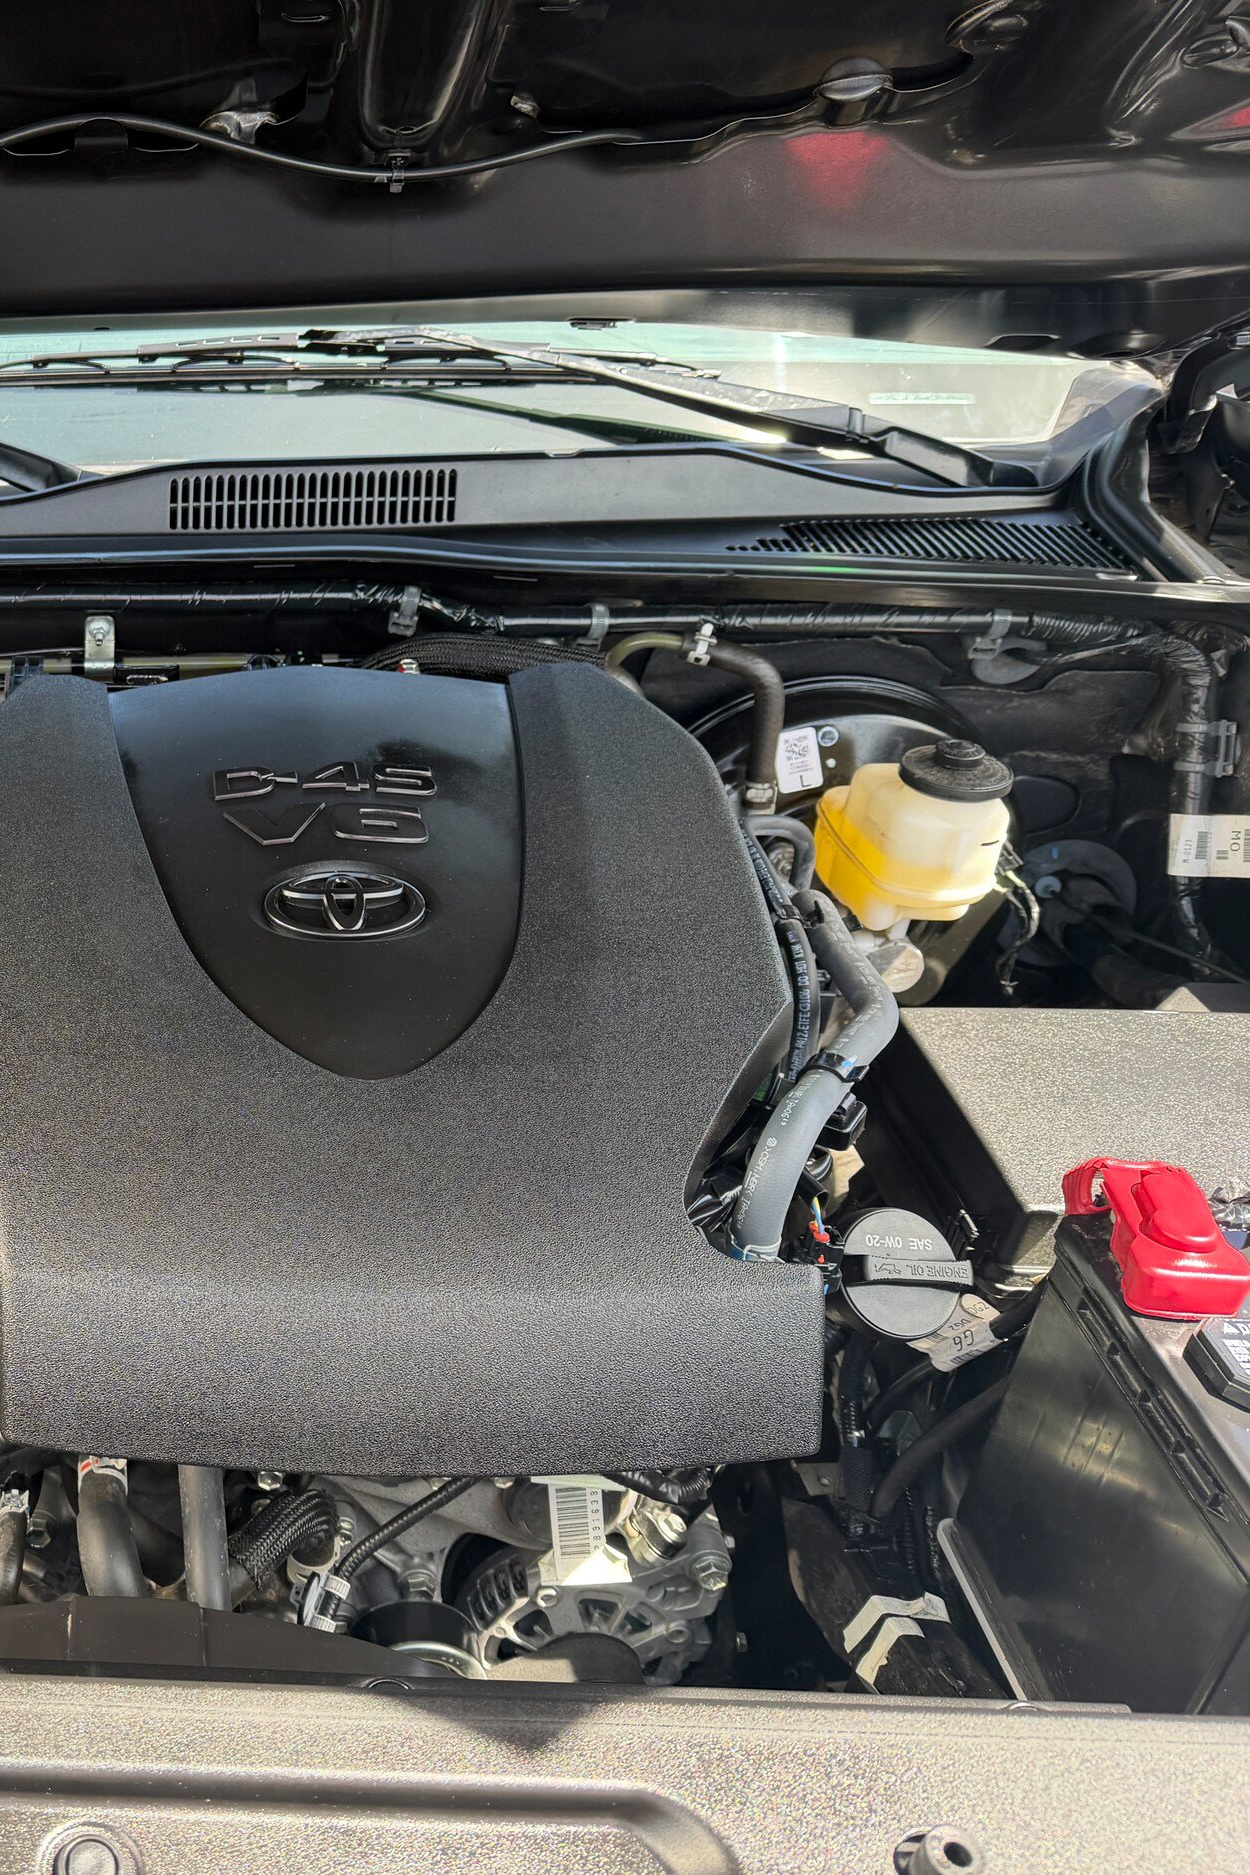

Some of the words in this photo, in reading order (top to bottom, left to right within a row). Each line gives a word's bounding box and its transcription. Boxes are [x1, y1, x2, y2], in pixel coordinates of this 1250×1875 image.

[213, 761, 437, 801] D-4S
[799, 775, 812, 787] L
[223, 802, 429, 845] V6
[1230, 830, 1241, 852] MO
[865, 1234, 903, 1249] 0W-20
[909, 1237, 933, 1251] SAE
[906, 1264, 924, 1276] OIL
[926, 1265, 969, 1279] ENGINE
